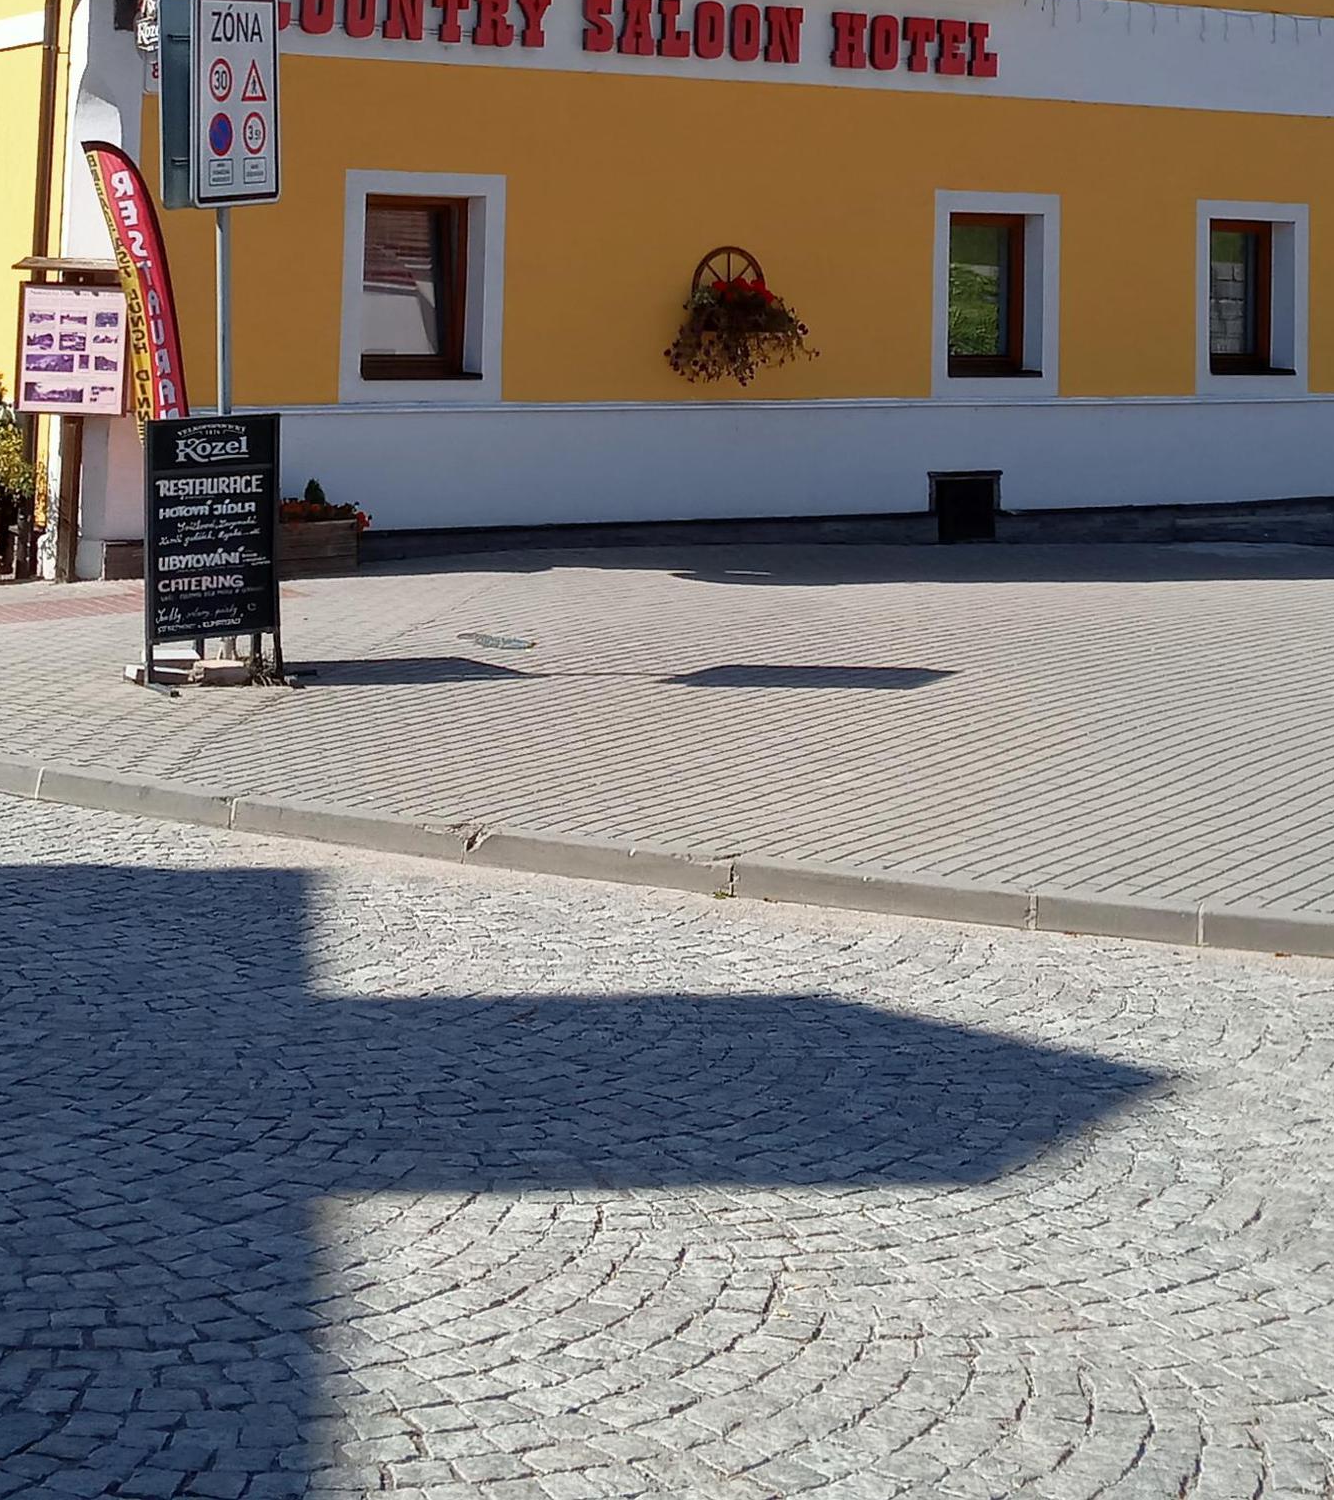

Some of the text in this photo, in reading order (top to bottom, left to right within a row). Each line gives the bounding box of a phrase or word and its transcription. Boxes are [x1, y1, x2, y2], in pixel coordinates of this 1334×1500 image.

[210, 3, 263, 43] ZÓNA
[829, 11, 998, 78] HOTEL
[213, 70, 228, 90] 30
[175, 435, 249, 463] Kozel
[154, 474, 264, 498] RESTAURACE
[158, 498, 256, 520] HOTOVÁ JÍDLA
[157, 545, 245, 572] UBYTOVÁNÍ
[157, 574, 245, 593] CATERING
